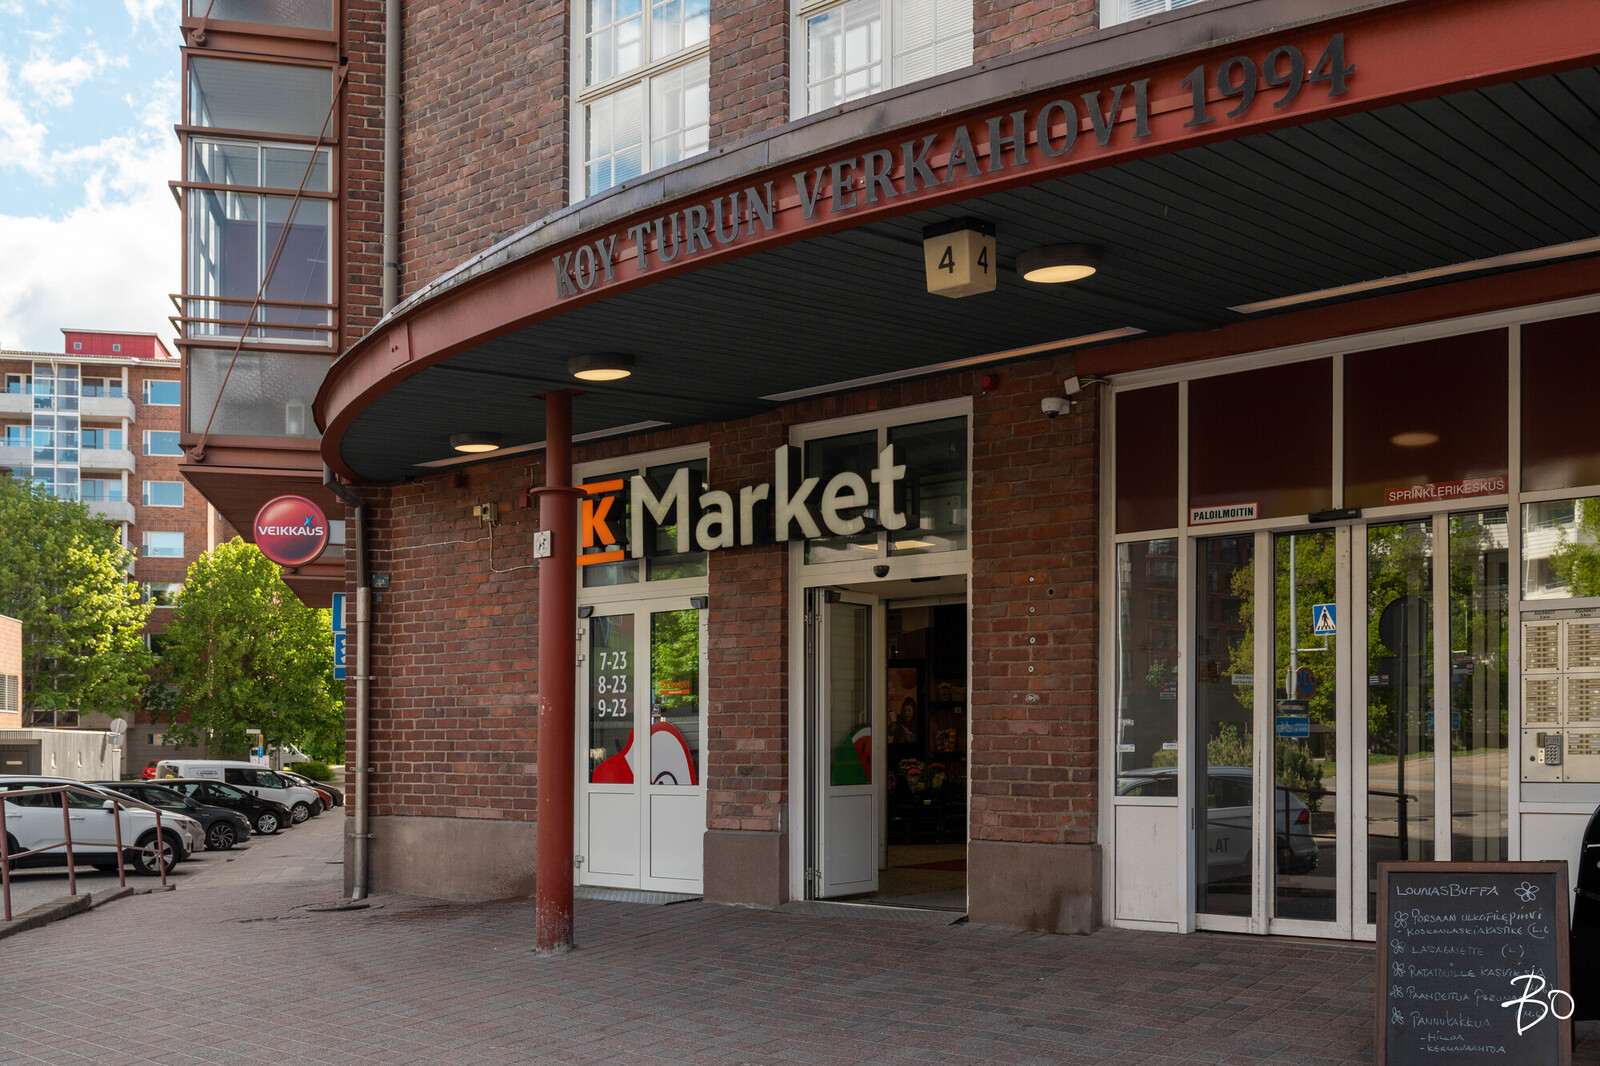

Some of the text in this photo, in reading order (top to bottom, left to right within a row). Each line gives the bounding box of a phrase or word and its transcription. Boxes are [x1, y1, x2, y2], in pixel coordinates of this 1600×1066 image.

[552, 33, 1356, 299] KOY TURUN VERKAHOVI 1994
[938, 245, 955, 274] 4
[977, 245, 989, 274] 4
[630, 443, 907, 559] Market
[1388, 480, 1505, 502] SPRINKLERIKESKUS
[1193, 507, 1254, 521] PALOILMOITIN
[258, 526, 324, 536] VEIKKAUS
[600, 651, 627, 671] 7-23
[598, 675, 627, 694] 8-23
[598, 699, 627, 718] 9-23
